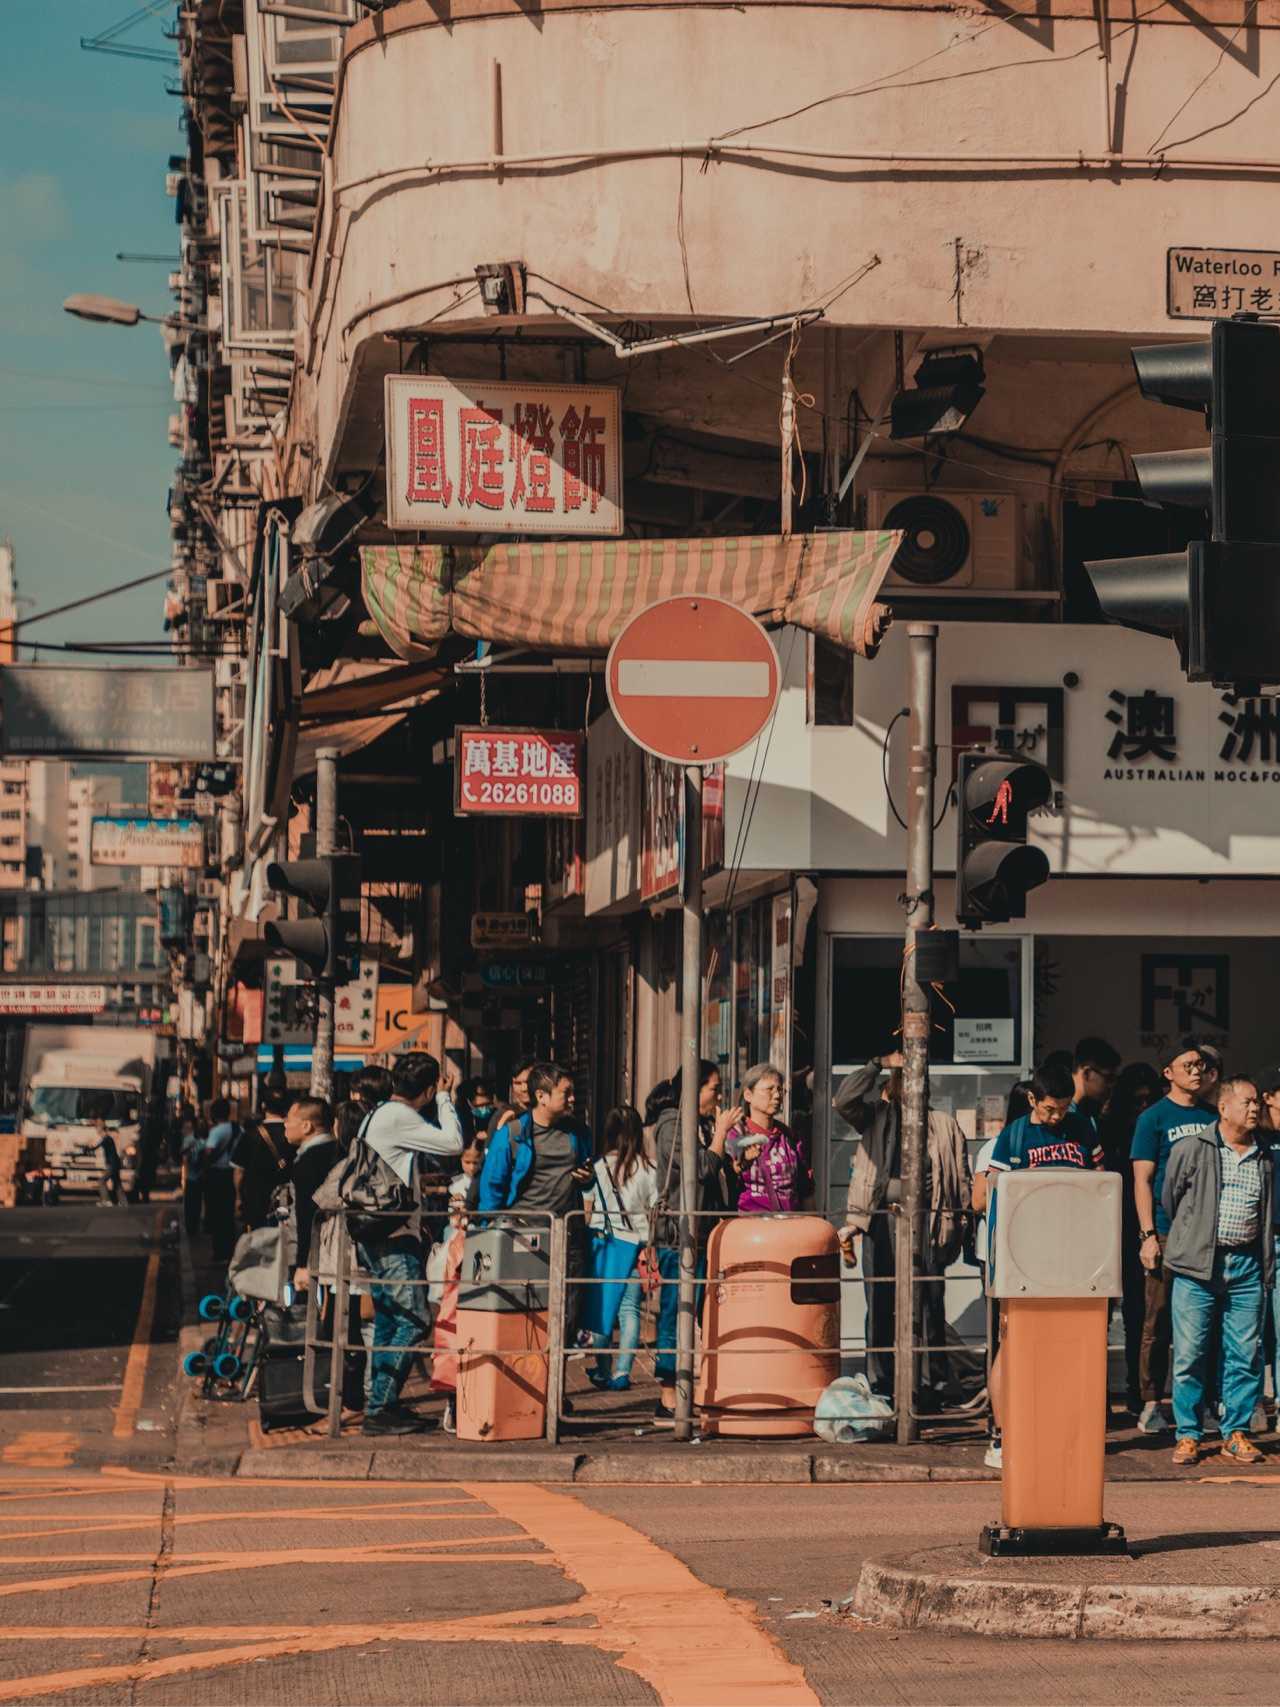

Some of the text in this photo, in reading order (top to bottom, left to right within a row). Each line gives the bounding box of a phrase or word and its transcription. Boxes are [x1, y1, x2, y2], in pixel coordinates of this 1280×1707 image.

[1176, 255, 1262, 277] Waterloo
[464, 740, 577, 778] 萬基地產
[1104, 769, 1205, 781] AUSTRALIAN
[480, 782, 575, 805] 26261088
[1028, 1142, 1085, 1168] DICKIES
